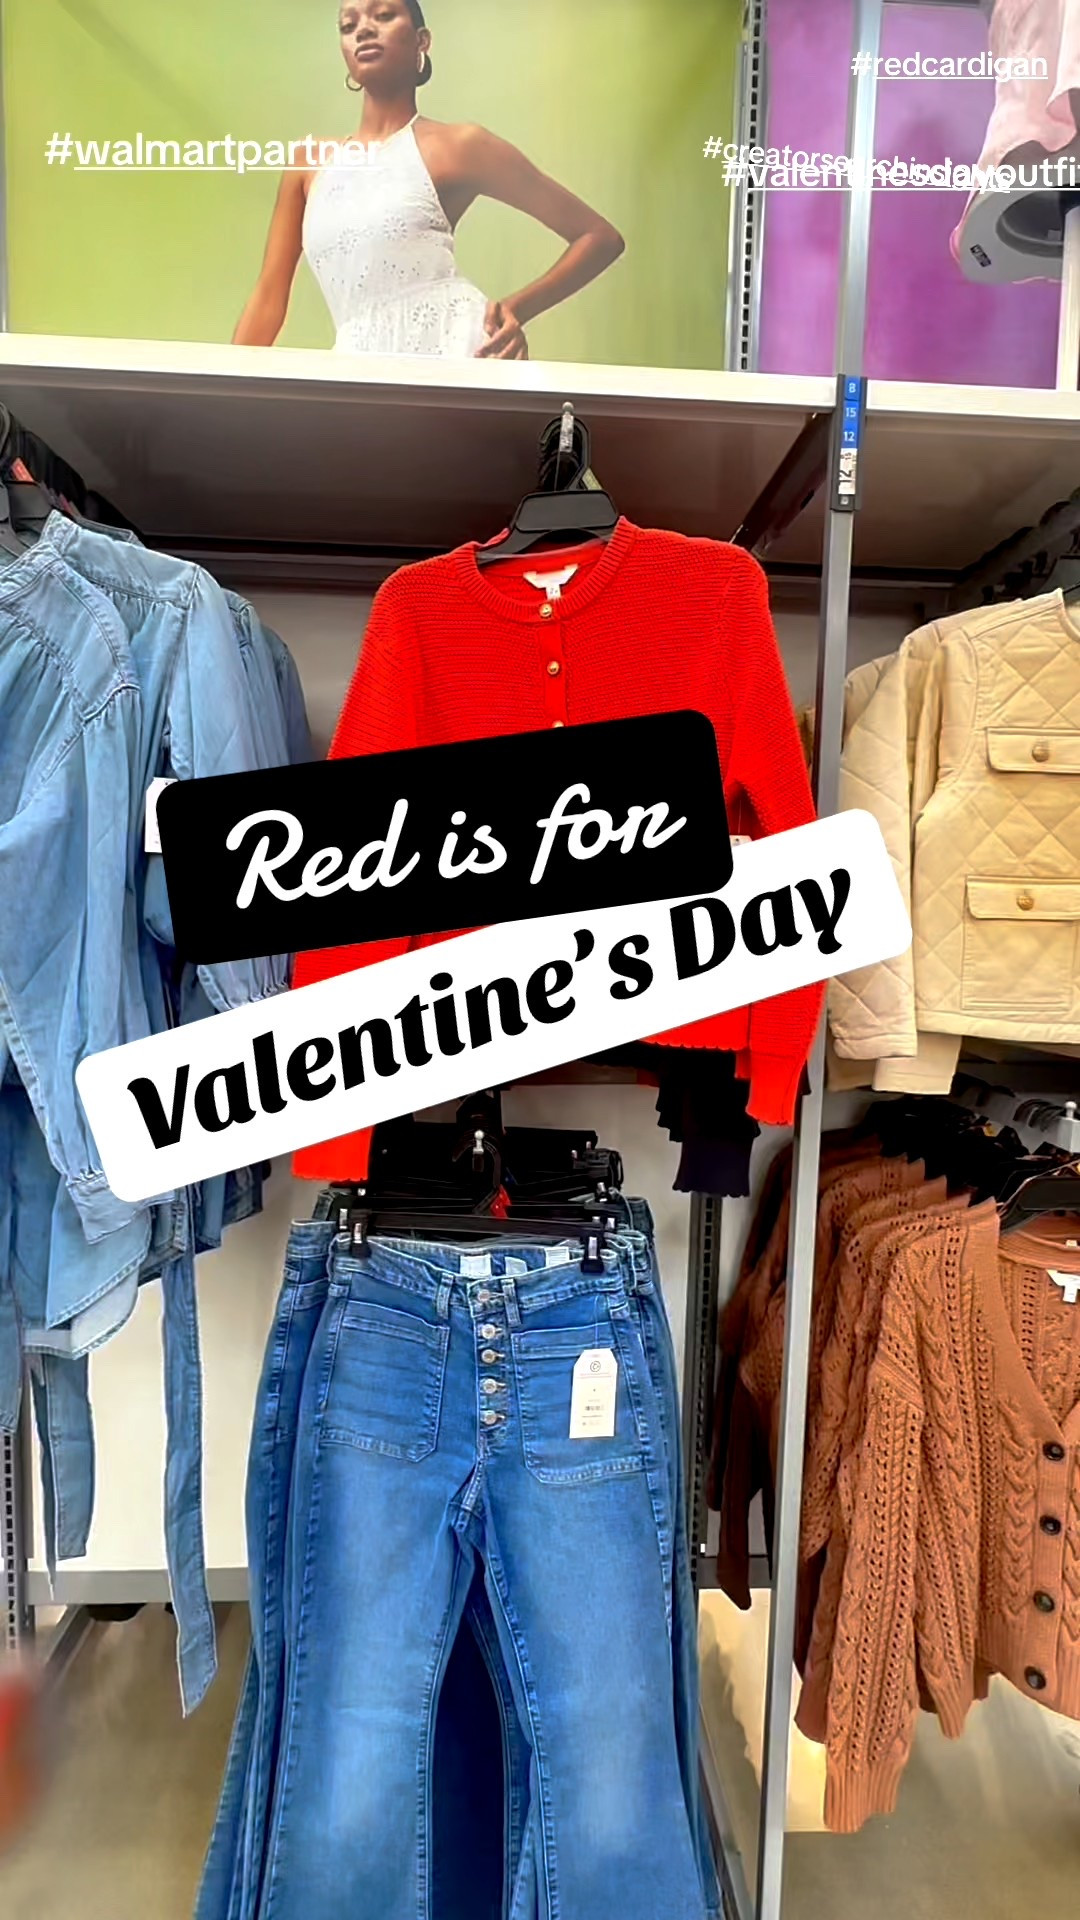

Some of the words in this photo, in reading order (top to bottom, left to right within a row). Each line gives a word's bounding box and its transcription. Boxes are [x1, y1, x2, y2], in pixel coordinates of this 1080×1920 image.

[848, 382, 857, 394] 8
[845, 407, 857, 418] 15
[843, 431, 855, 442] 12
